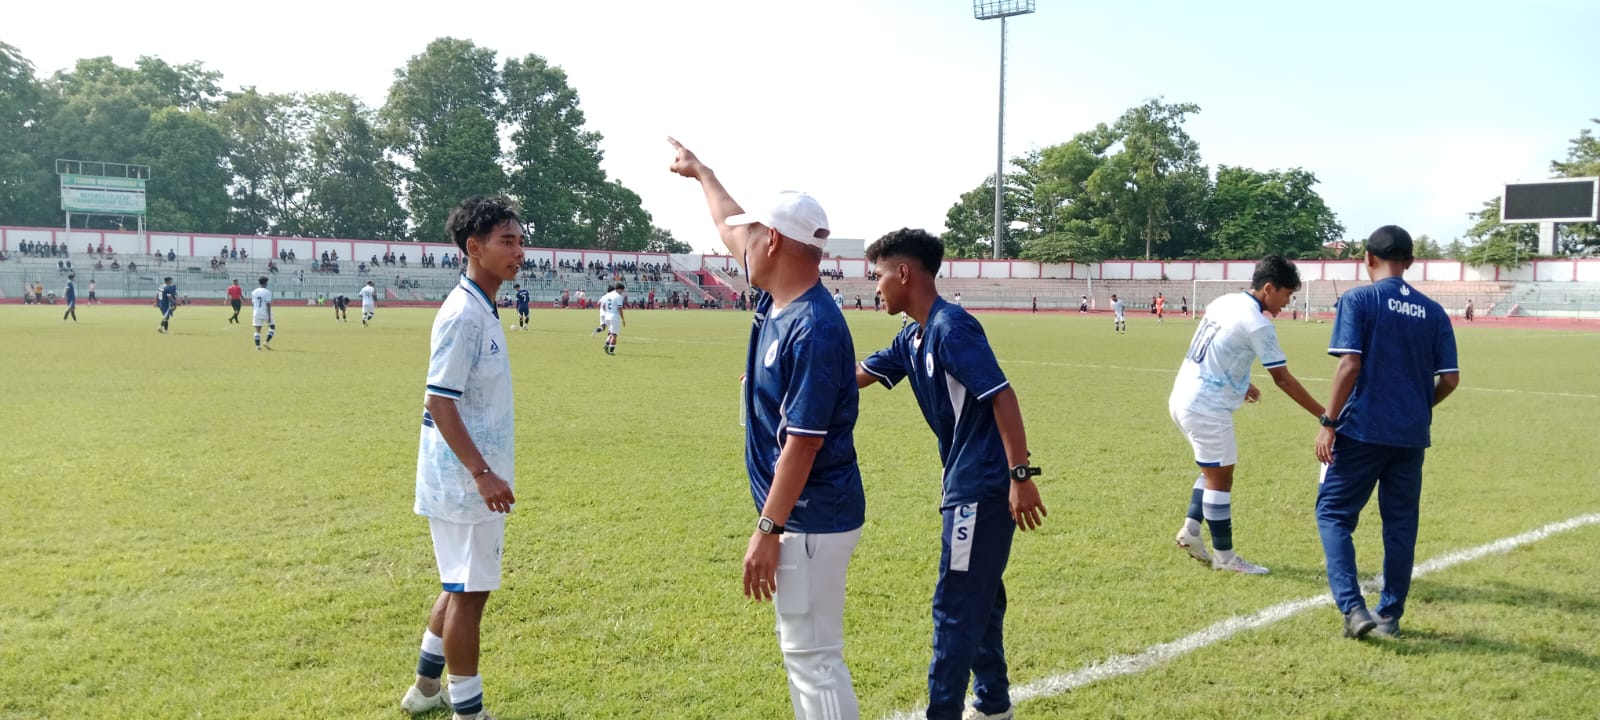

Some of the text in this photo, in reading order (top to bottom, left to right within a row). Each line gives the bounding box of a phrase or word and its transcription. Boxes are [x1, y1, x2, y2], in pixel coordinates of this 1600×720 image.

[257, 296, 263, 308] 7
[1388, 298, 1426, 319] COACH
[1186, 317, 1221, 364] 10
